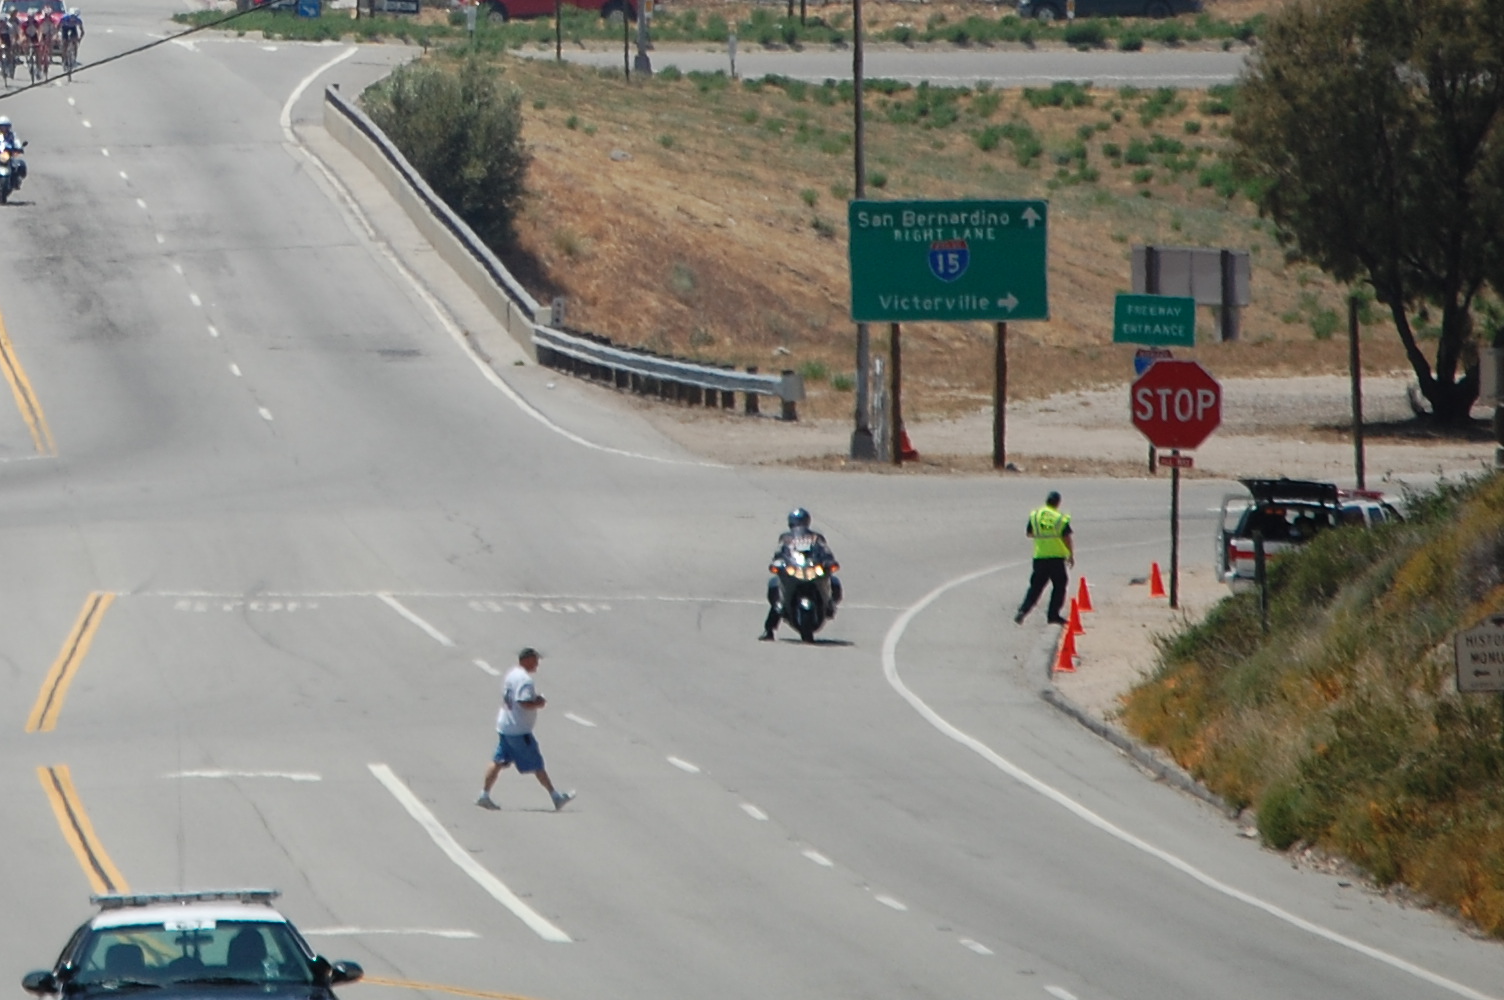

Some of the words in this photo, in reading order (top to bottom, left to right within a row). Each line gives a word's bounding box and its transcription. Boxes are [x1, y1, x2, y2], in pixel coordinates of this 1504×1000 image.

[857, 210, 894, 228] San
[902, 210, 1010, 227] Bernardino
[894, 228, 944, 242] RIGHT
[952, 227, 996, 241] LANE
[937, 253, 960, 274] 15
[879, 294, 990, 311] Victorville
[1126, 304, 1183, 317] FREEWAY
[1122, 323, 1186, 337] ENTRANCE
[1135, 388, 1216, 422] STOP
[1465, 634, 1504, 647] HISTO
